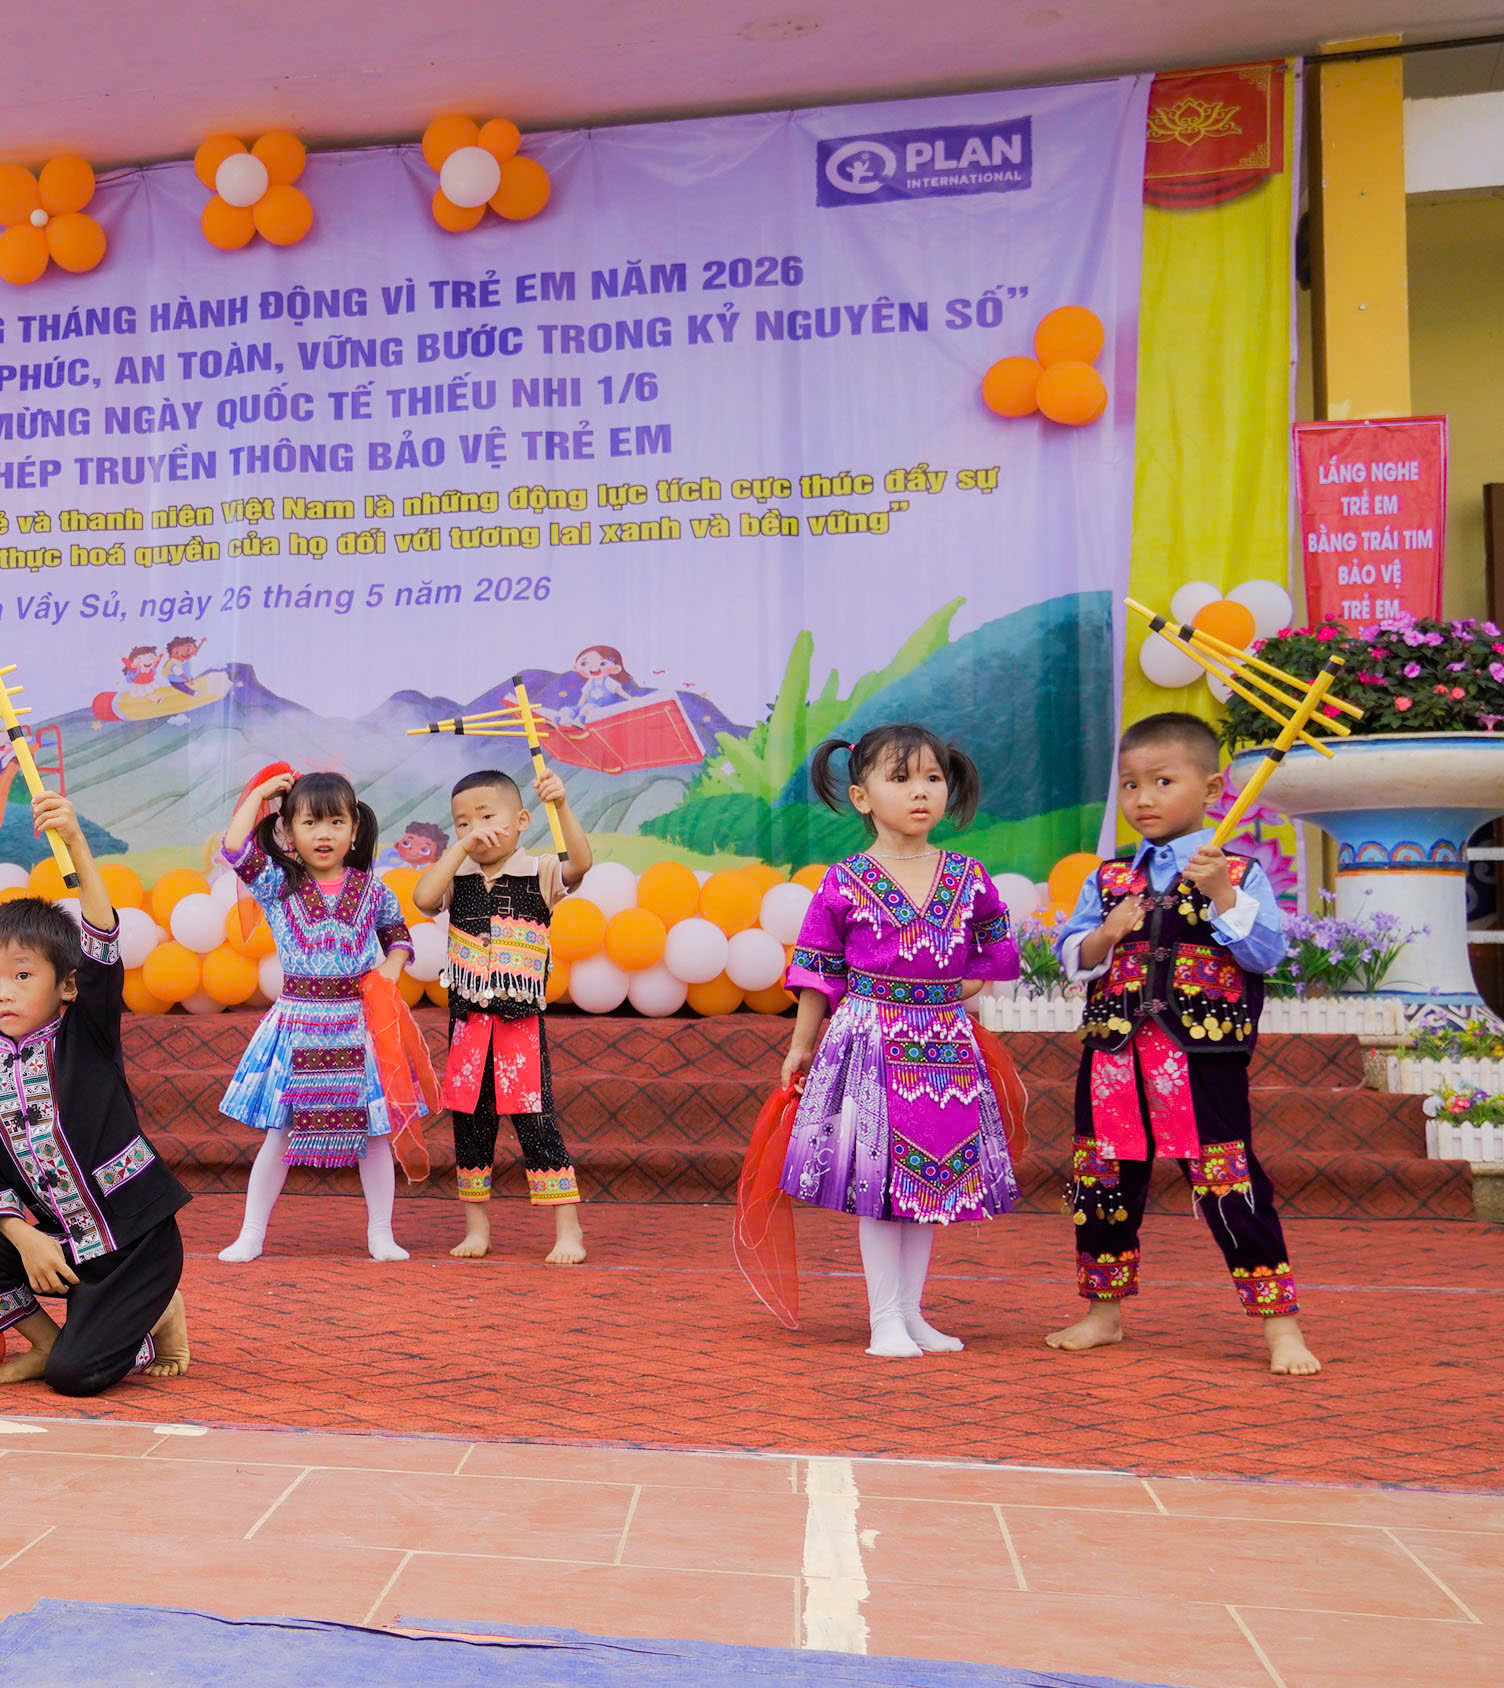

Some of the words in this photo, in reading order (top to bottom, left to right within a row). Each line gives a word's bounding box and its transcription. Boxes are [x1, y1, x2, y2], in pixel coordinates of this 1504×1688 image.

[905, 134, 1023, 173] PLAN
[906, 170, 1023, 190] INTERNATIONAL
[17, 303, 137, 343] THÁNG
[149, 295, 249, 333] HÀNH
[259, 284, 368, 327] ĐỘNG
[381, 279, 416, 316] VÌ
[429, 270, 501, 309] TRẺ
[515, 271, 576, 304] EM
[591, 259, 687, 301] NĂM
[702, 256, 805, 291] 2026
[114, 354, 166, 386] AN
[177, 342, 284, 380] TOÀN,
[297, 333, 404, 372] VỮNG
[416, 324, 524, 364] BƯỚC
[537, 317, 673, 355] TRONG
[687, 302, 741, 346] KỶ
[755, 296, 929, 342] NGUYÊN
[944, 285, 1029, 330] SỐ”
[104, 397, 203, 435] NGÀY
[216, 383, 315, 430] QUỐC
[328, 380, 375, 422] TẾ
[387, 371, 497, 417] THIẾU
[511, 377, 581, 408] NHI
[596, 372, 659, 406] 1/6
[74, 443, 217, 486] TRUYỀN
[229, 438, 354, 476] THÔNG
[368, 429, 446, 471] BẢO
[459, 426, 507, 469] VỆ
[521, 420, 595, 461] TRẺ
[609, 424, 673, 458] EM
[1318, 455, 1367, 485] LẮNG
[1371, 461, 1420, 483] NGHE
[16, 509, 52, 535] và
[59, 508, 144, 532] thanh
[151, 504, 214, 530] niên
[220, 496, 275, 526] Việt
[282, 496, 356, 520] Nam
[364, 494, 394, 520] là
[402, 490, 499, 517] những
[509, 484, 588, 514] động
[597, 483, 648, 511] lực
[655, 476, 721, 504] tích
[730, 476, 792, 504] cực
[799, 471, 874, 499] thúc
[884, 462, 948, 495] đẩy
[955, 465, 1001, 494] sự
[1340, 488, 1370, 516] TRẺ
[1374, 495, 1399, 515] EM
[70, 542, 126, 568] hoá
[134, 535, 221, 569] quyền
[227, 531, 280, 559] của
[288, 532, 328, 560] họ
[336, 528, 387, 556] đối
[393, 527, 442, 553] với
[449, 523, 541, 549] tương
[548, 520, 591, 547] lai
[599, 516, 682, 544] xanh
[689, 512, 731, 539] và
[739, 508, 800, 538] bền
[807, 499, 910, 536] vững”
[1307, 523, 1357, 553] BẰNG
[1361, 525, 1399, 551] TRÁI
[1403, 529, 1433, 549] TIM
[1338, 559, 1376, 585] BẢO
[1380, 558, 1402, 589] VỆ
[15, 591, 69, 626] Vầy
[79, 591, 128, 623] Sủ,
[139, 590, 212, 623] ngày
[219, 585, 252, 613] 26
[262, 583, 355, 615] tháng
[365, 583, 384, 608] 5
[394, 580, 462, 607] năm
[473, 576, 552, 603] 2026
[1342, 592, 1371, 620] TRẺ
[1375, 598, 1400, 619] EM
